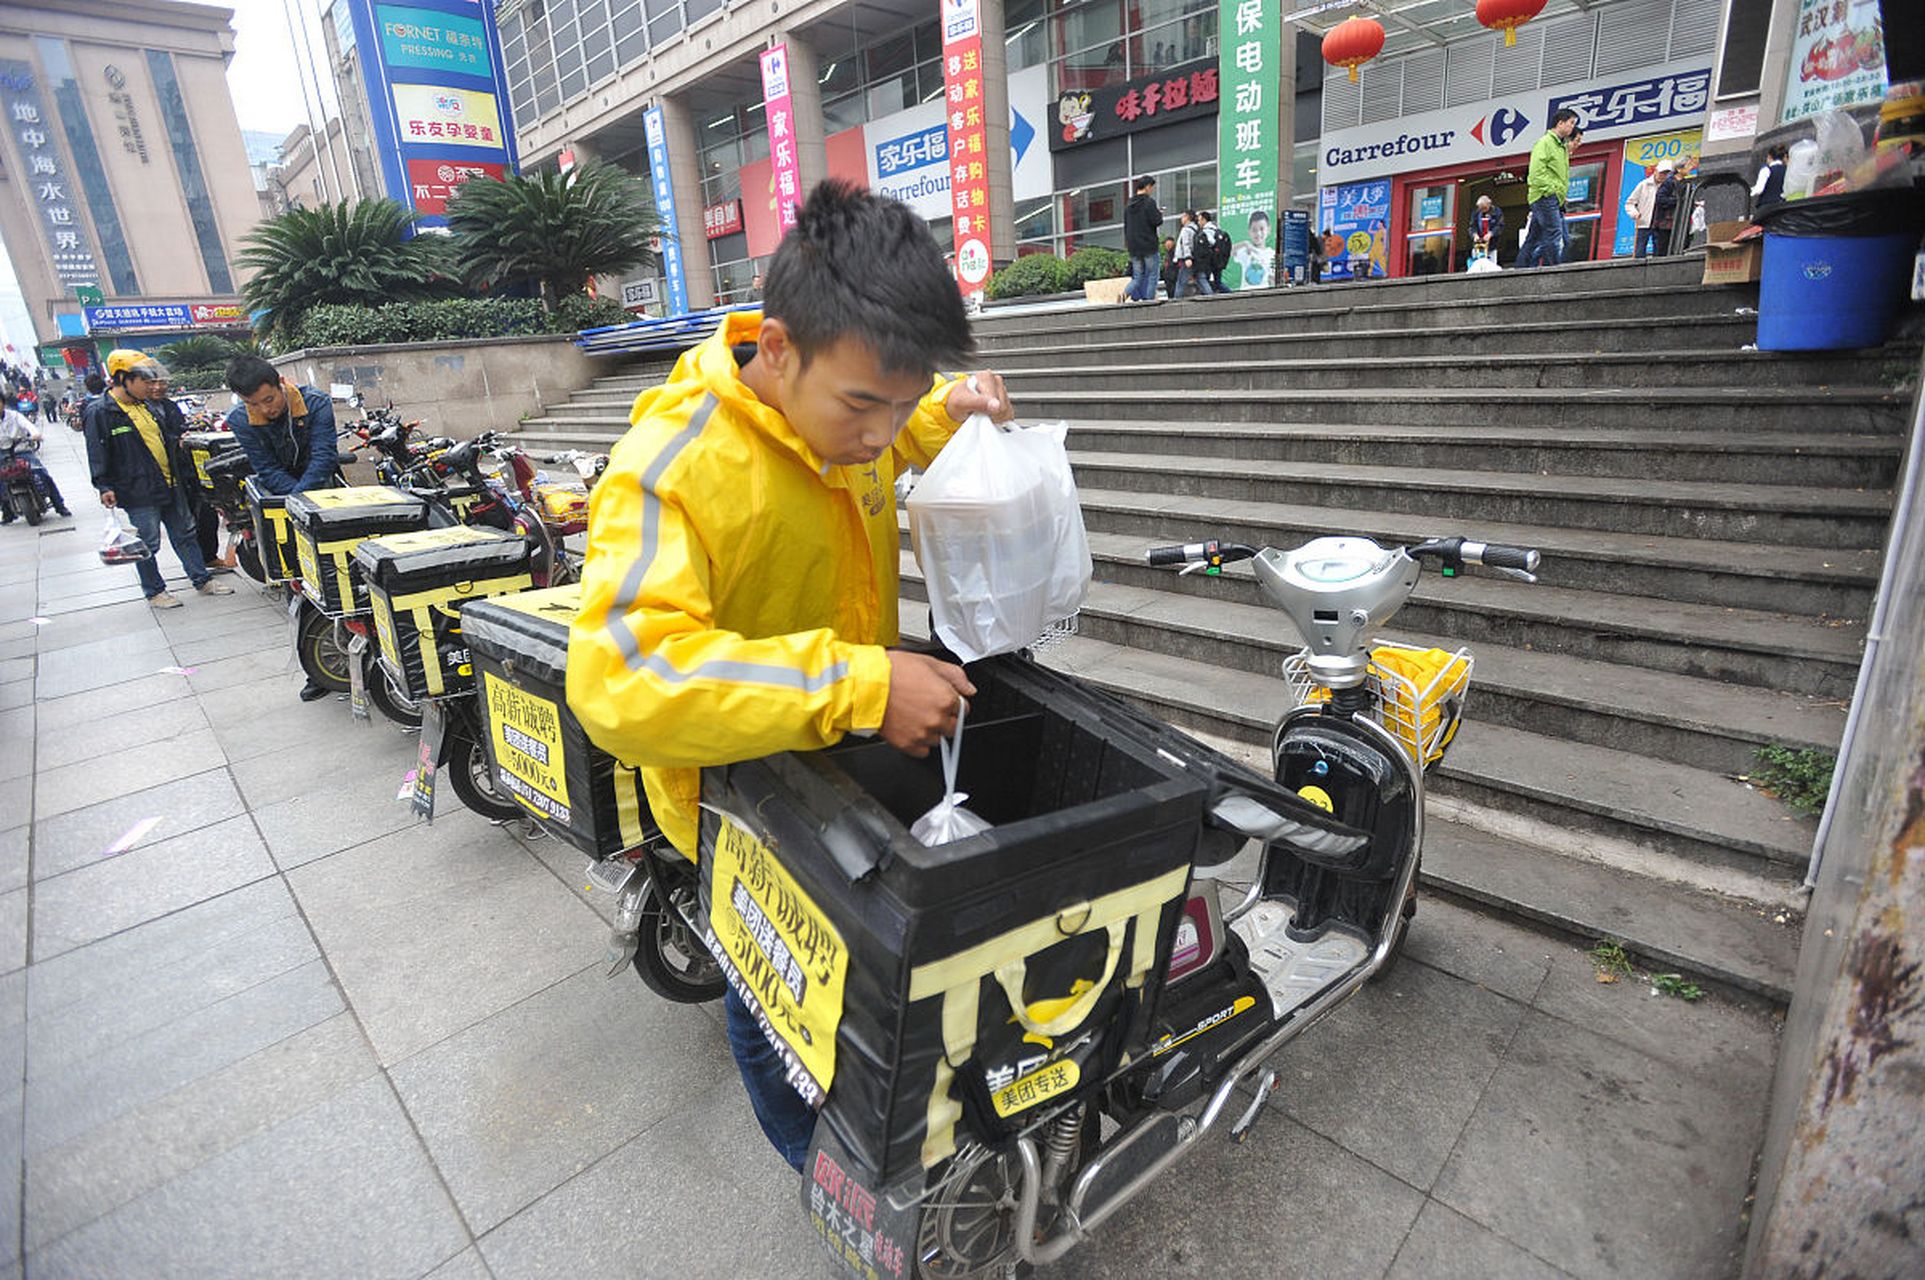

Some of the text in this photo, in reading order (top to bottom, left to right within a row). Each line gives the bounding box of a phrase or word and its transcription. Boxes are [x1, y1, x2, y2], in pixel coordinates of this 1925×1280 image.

[384, 22, 441, 42] FORNET
[400, 44, 453, 59] PRESSING
[1235, 0, 1263, 190] 保电动班车
[1558, 73, 1709, 129] 家乐福
[409, 121, 494, 142] 乐友孕婴童
[879, 131, 946, 172] 家乐福
[947, 55, 971, 235] 移动客户存话费
[963, 49, 986, 232] 送家乐福购物卡
[1326, 130, 1455, 167] Carrefour
[1640, 139, 1682, 160] 200
[12, 102, 80, 251] 地中海水世界
[1197, 1006, 1234, 1031] SPORT
[1001, 1066, 1068, 1110] 美团专送
